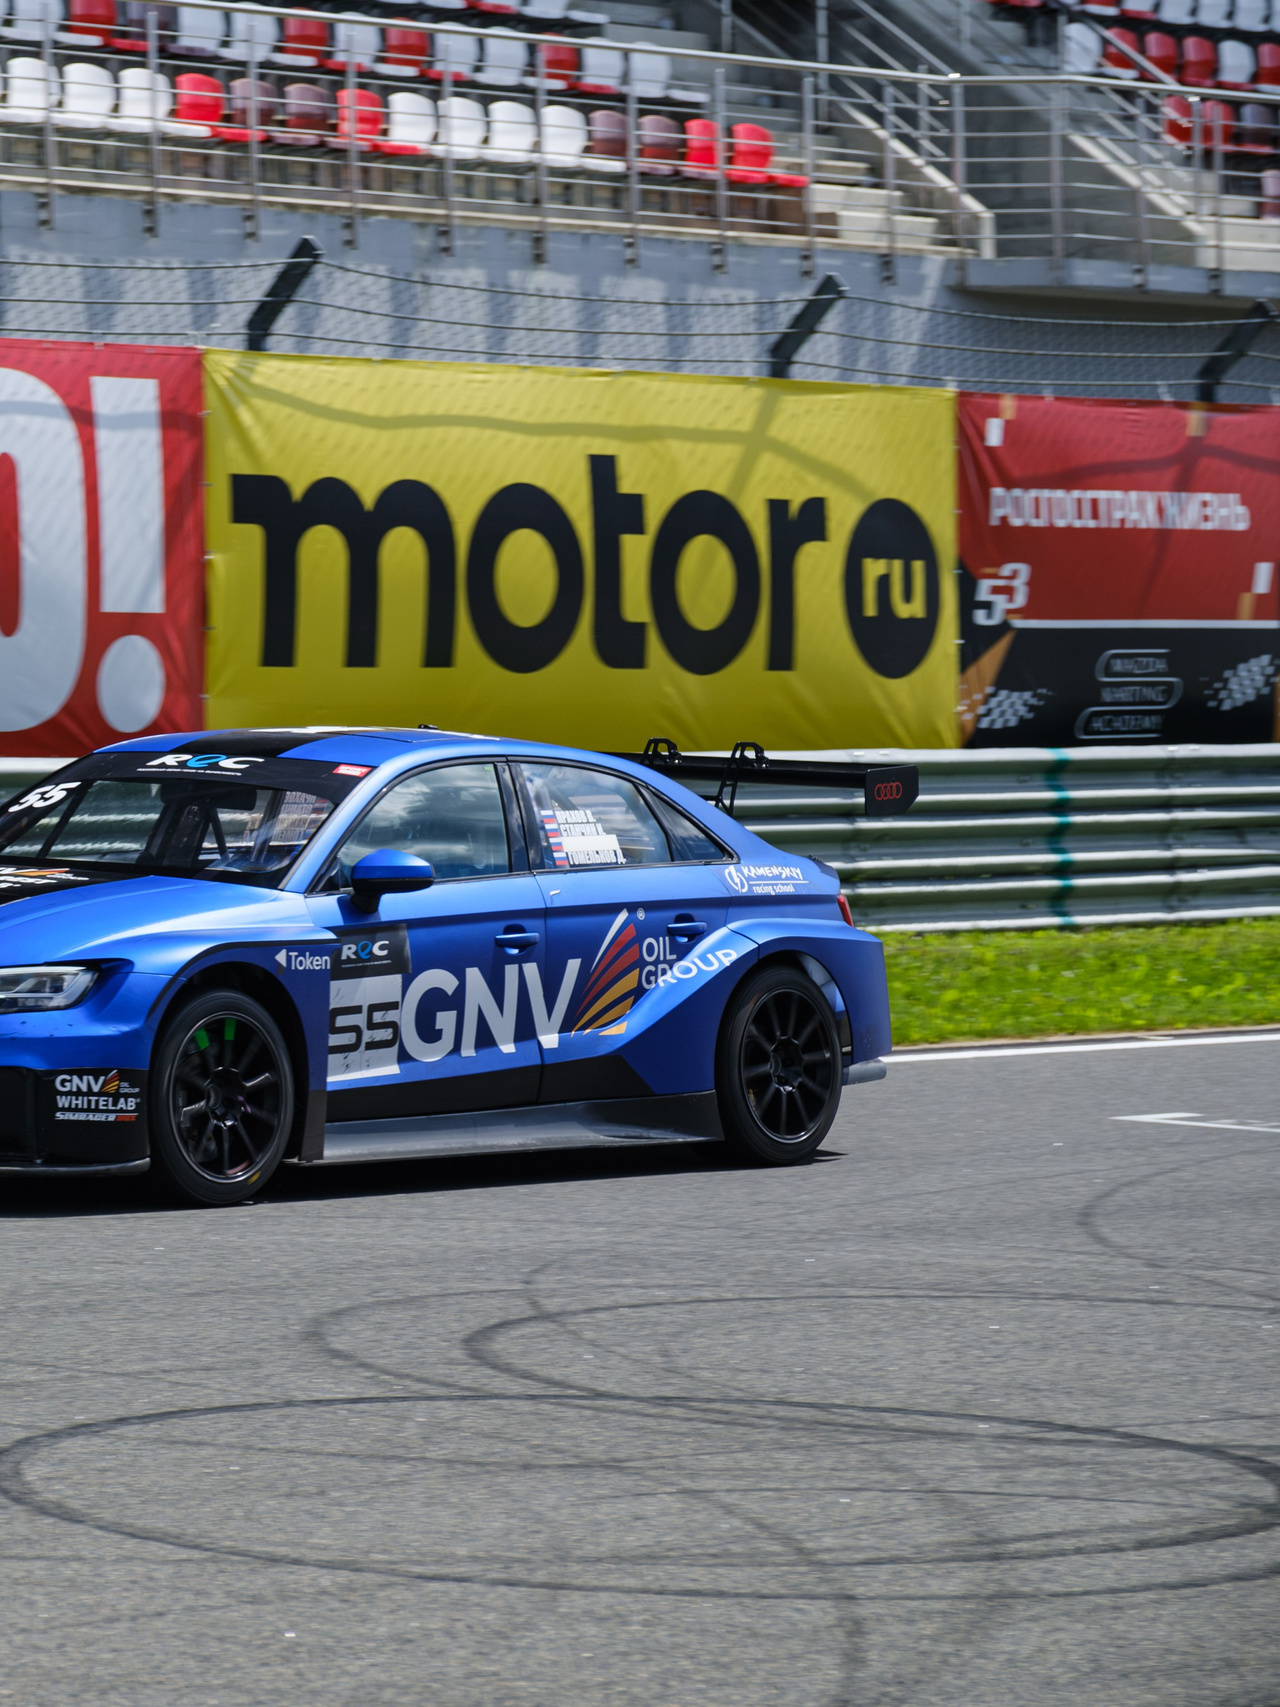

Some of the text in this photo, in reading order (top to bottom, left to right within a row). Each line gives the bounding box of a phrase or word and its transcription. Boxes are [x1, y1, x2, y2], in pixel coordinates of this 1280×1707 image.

[228, 453, 927, 677] motor ru
[7, 781, 82, 812] 55
[741, 865, 803, 880] KAMENSKIY
[753, 884, 795, 895] racing school
[288, 951, 331, 970] Token
[641, 936, 677, 961] OIL
[641, 949, 739, 990] GROUP
[400, 958, 582, 1063] GNV
[328, 1001, 400, 1055] 55
[54, 1074, 106, 1092] GNV
